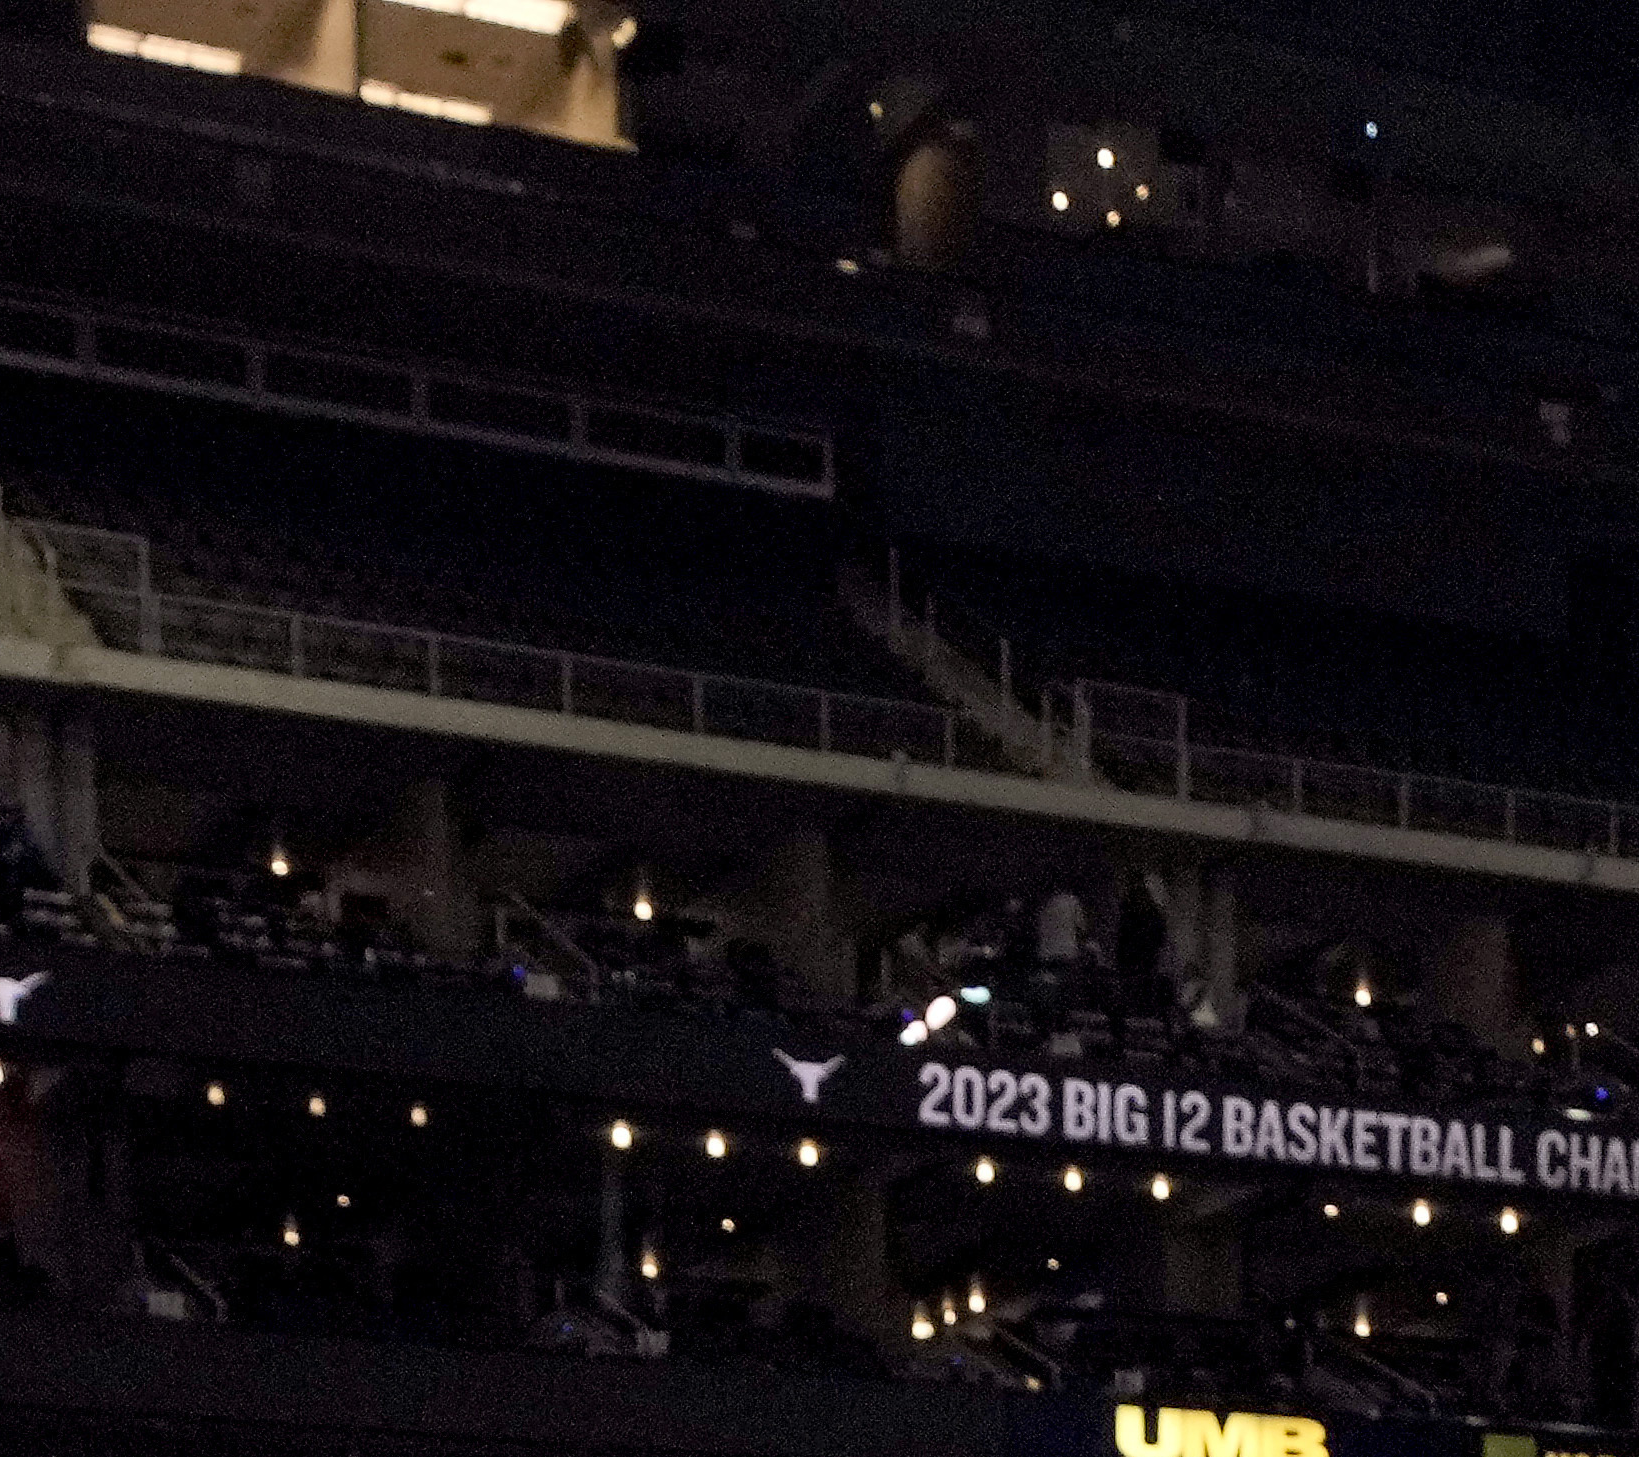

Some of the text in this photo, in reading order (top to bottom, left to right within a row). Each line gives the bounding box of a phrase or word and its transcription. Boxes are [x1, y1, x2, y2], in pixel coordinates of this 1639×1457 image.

[919, 1062, 1051, 1135] 2023
[1063, 1078, 1149, 1144] BIG
[1162, 1090, 1211, 1152] 12
[1222, 1096, 1523, 1183] BASKETBALL
